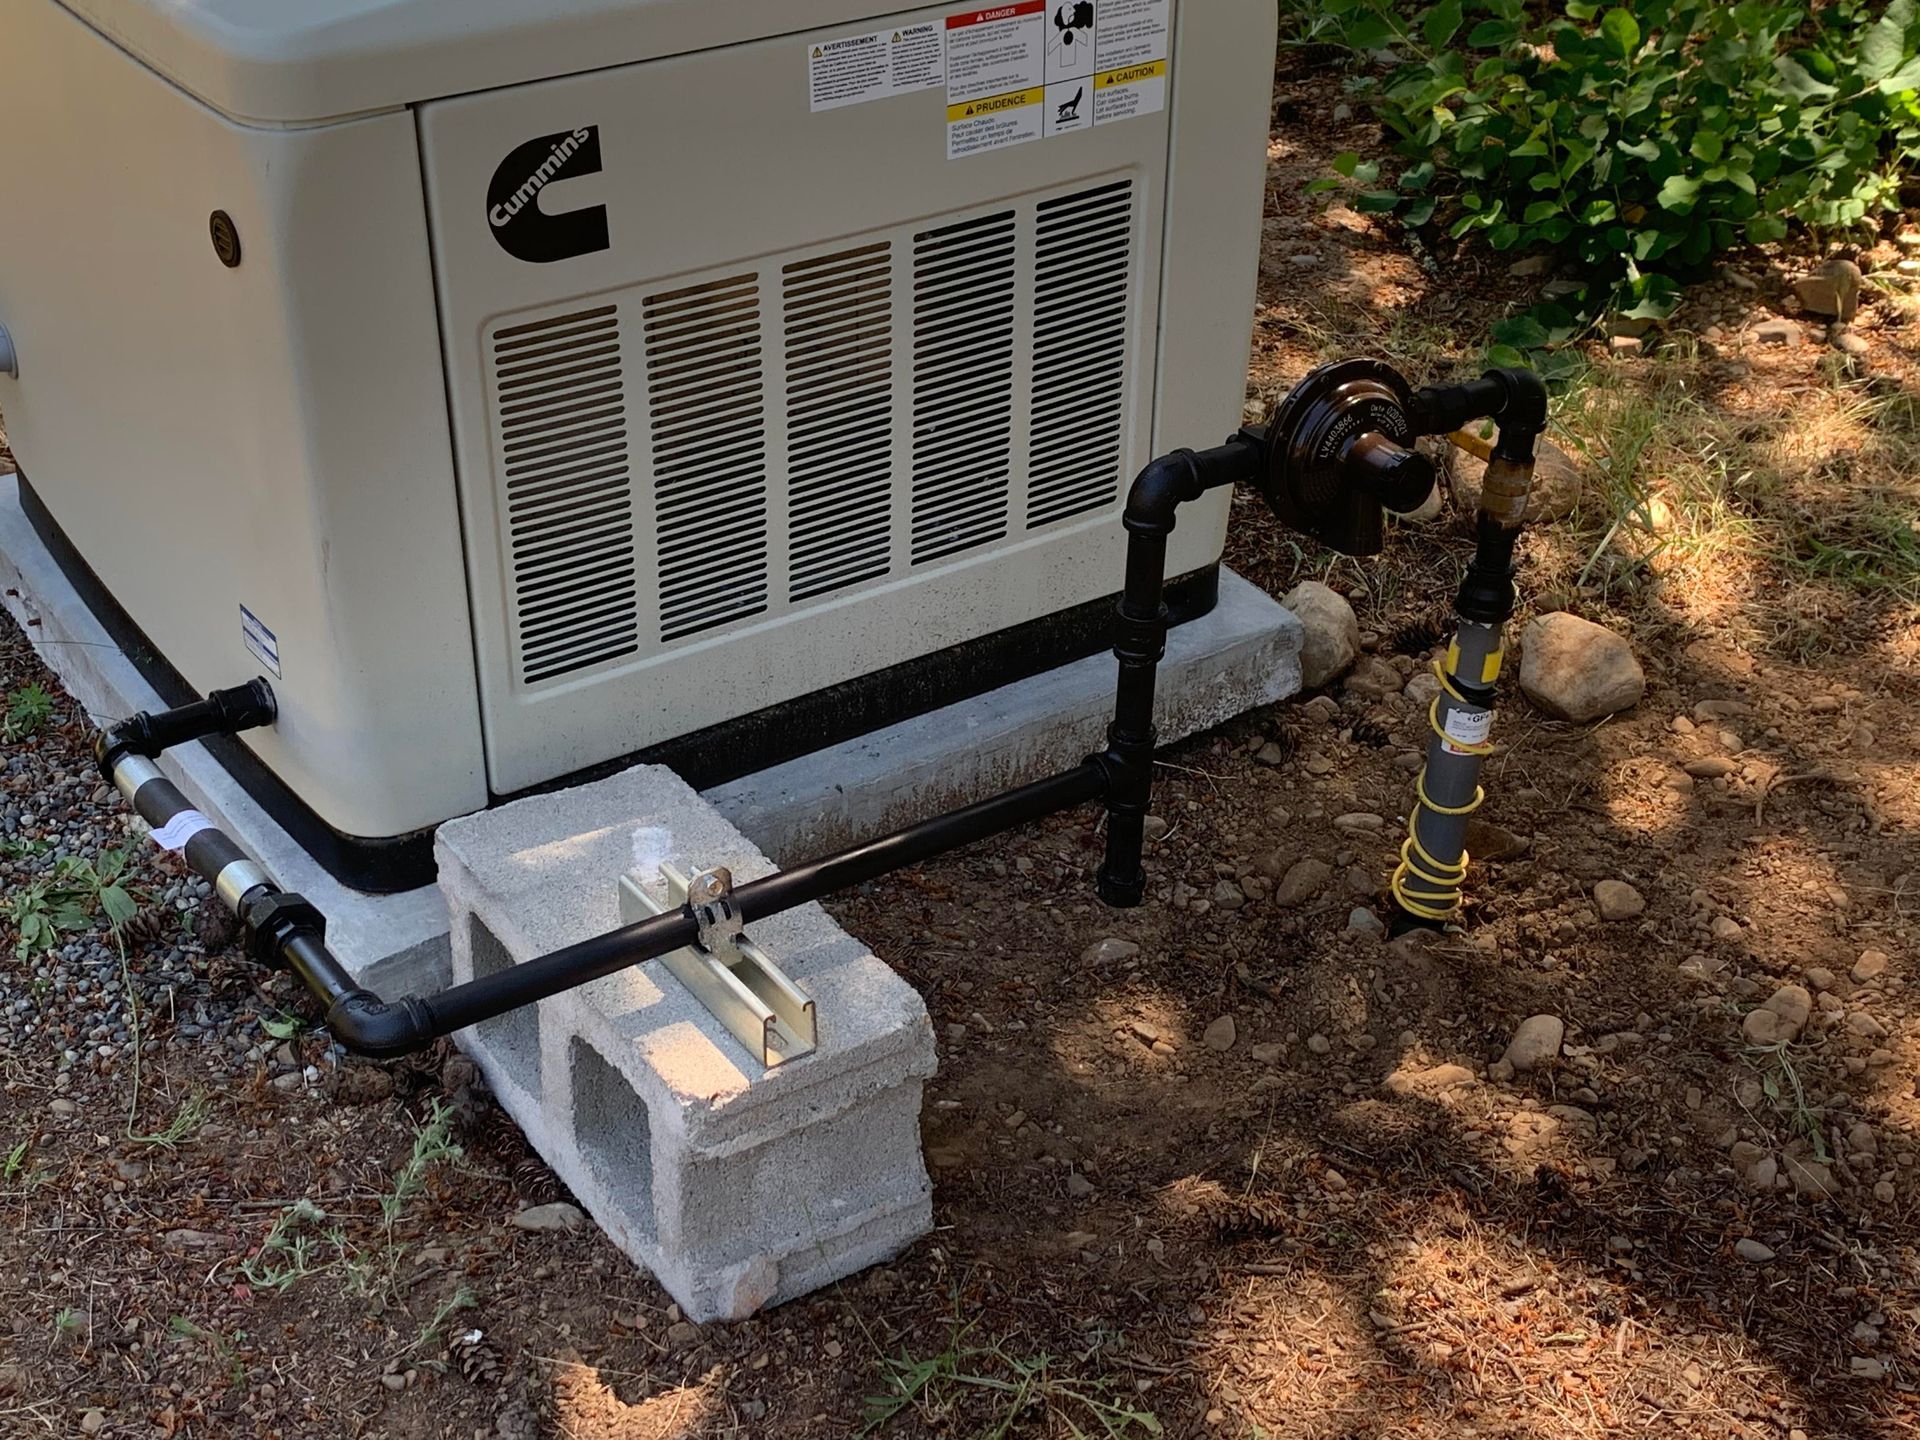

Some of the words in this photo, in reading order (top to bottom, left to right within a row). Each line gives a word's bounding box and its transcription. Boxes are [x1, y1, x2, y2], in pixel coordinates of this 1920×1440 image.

[985, 8, 1016, 20] DANGER
[902, 25, 933, 36] WARNING
[823, 35, 878, 51] AVERTISSEMENT
[1116, 66, 1155, 82] CAUTION
[976, 94, 1026, 113] PRUDENCE
[489, 129, 589, 227] Cummins
